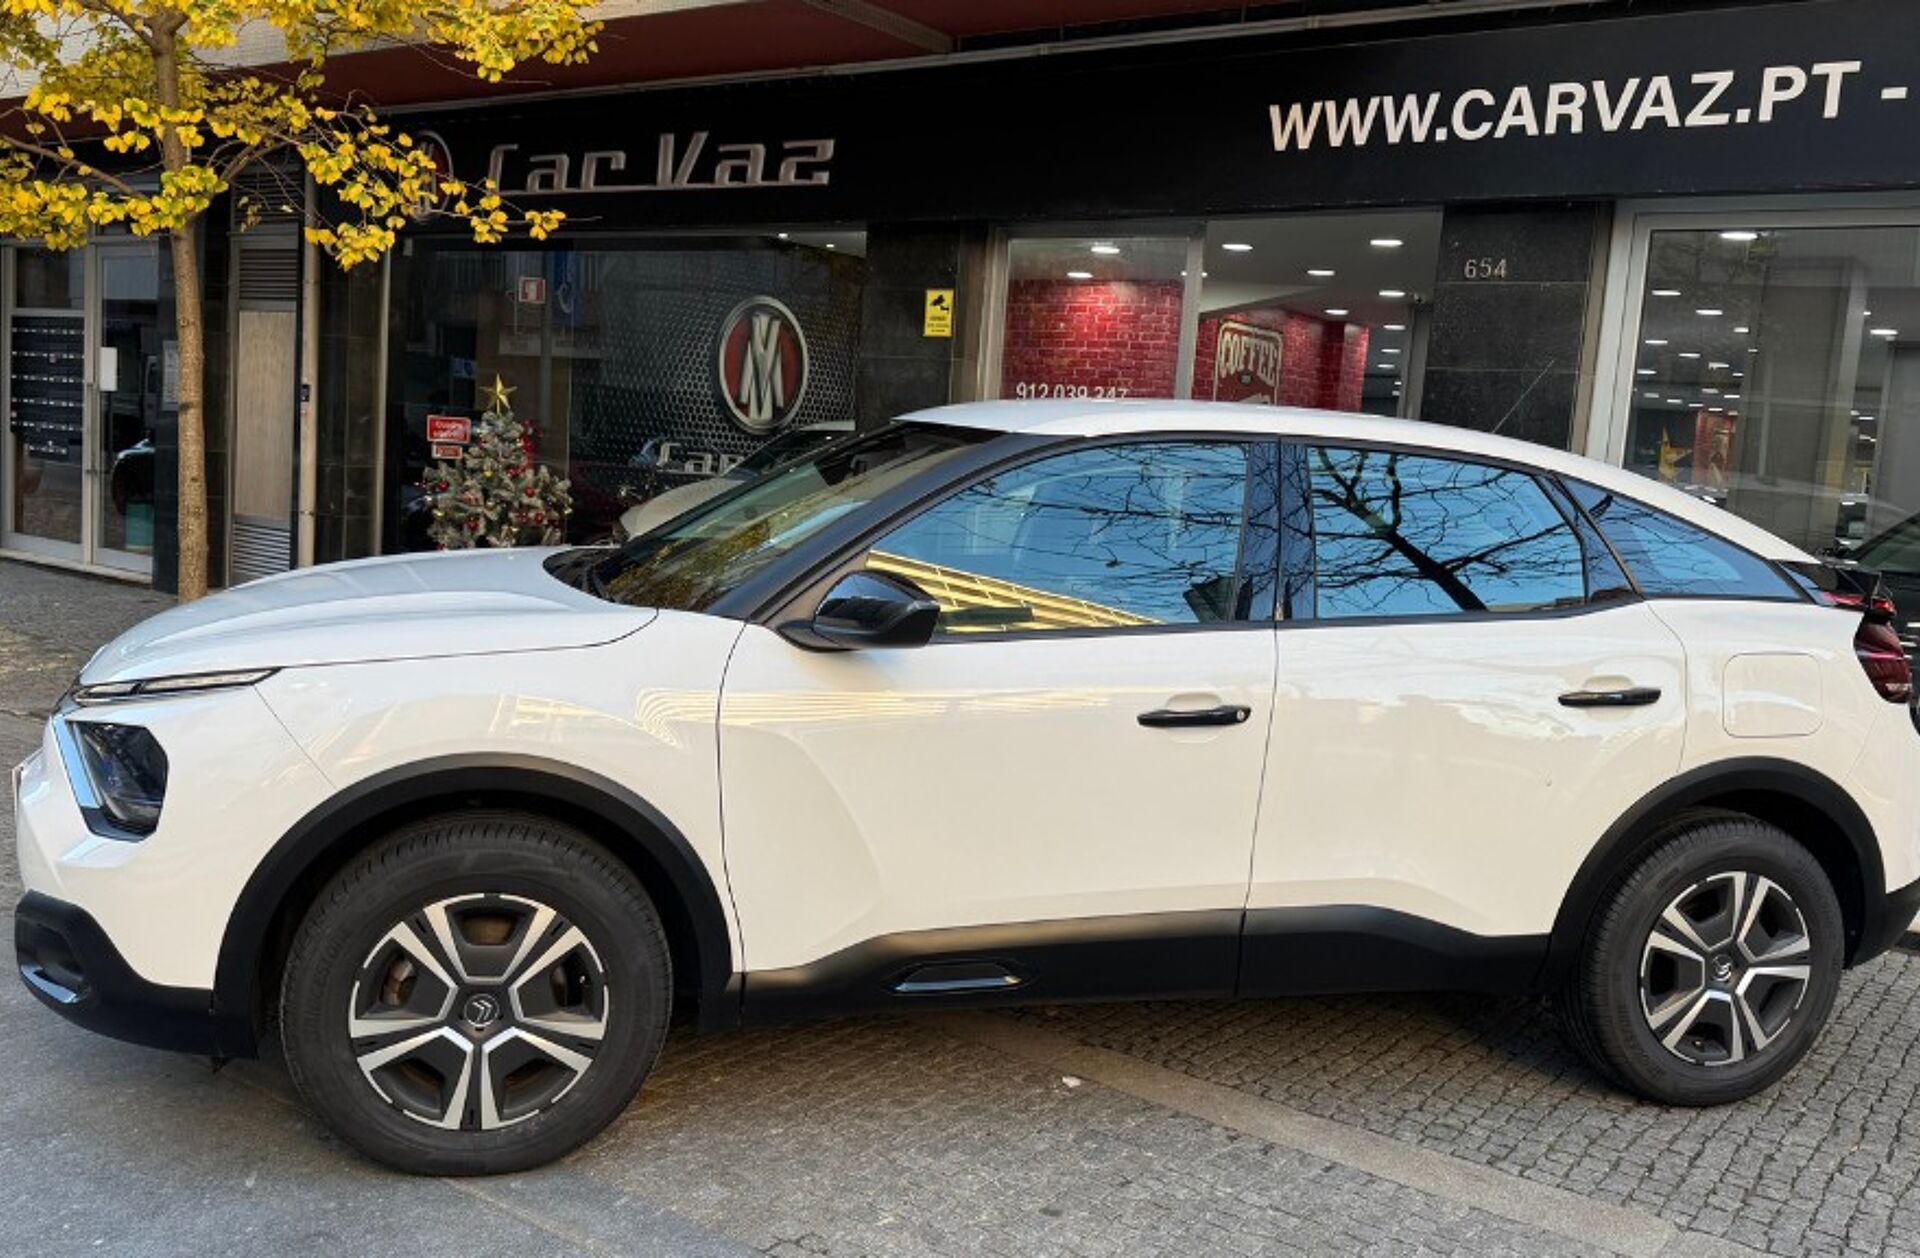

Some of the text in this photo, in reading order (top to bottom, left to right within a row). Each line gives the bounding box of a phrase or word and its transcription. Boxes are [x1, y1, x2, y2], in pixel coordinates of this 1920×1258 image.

[1269, 60, 1861, 152] WWW.CARVAZ.PT
[487, 131, 836, 196] Car Vaz
[1464, 257, 1507, 279] 654
[1219, 331, 1279, 388] COFFEE
[1016, 381, 1049, 399] 912
[1054, 384, 1088, 399] 039
